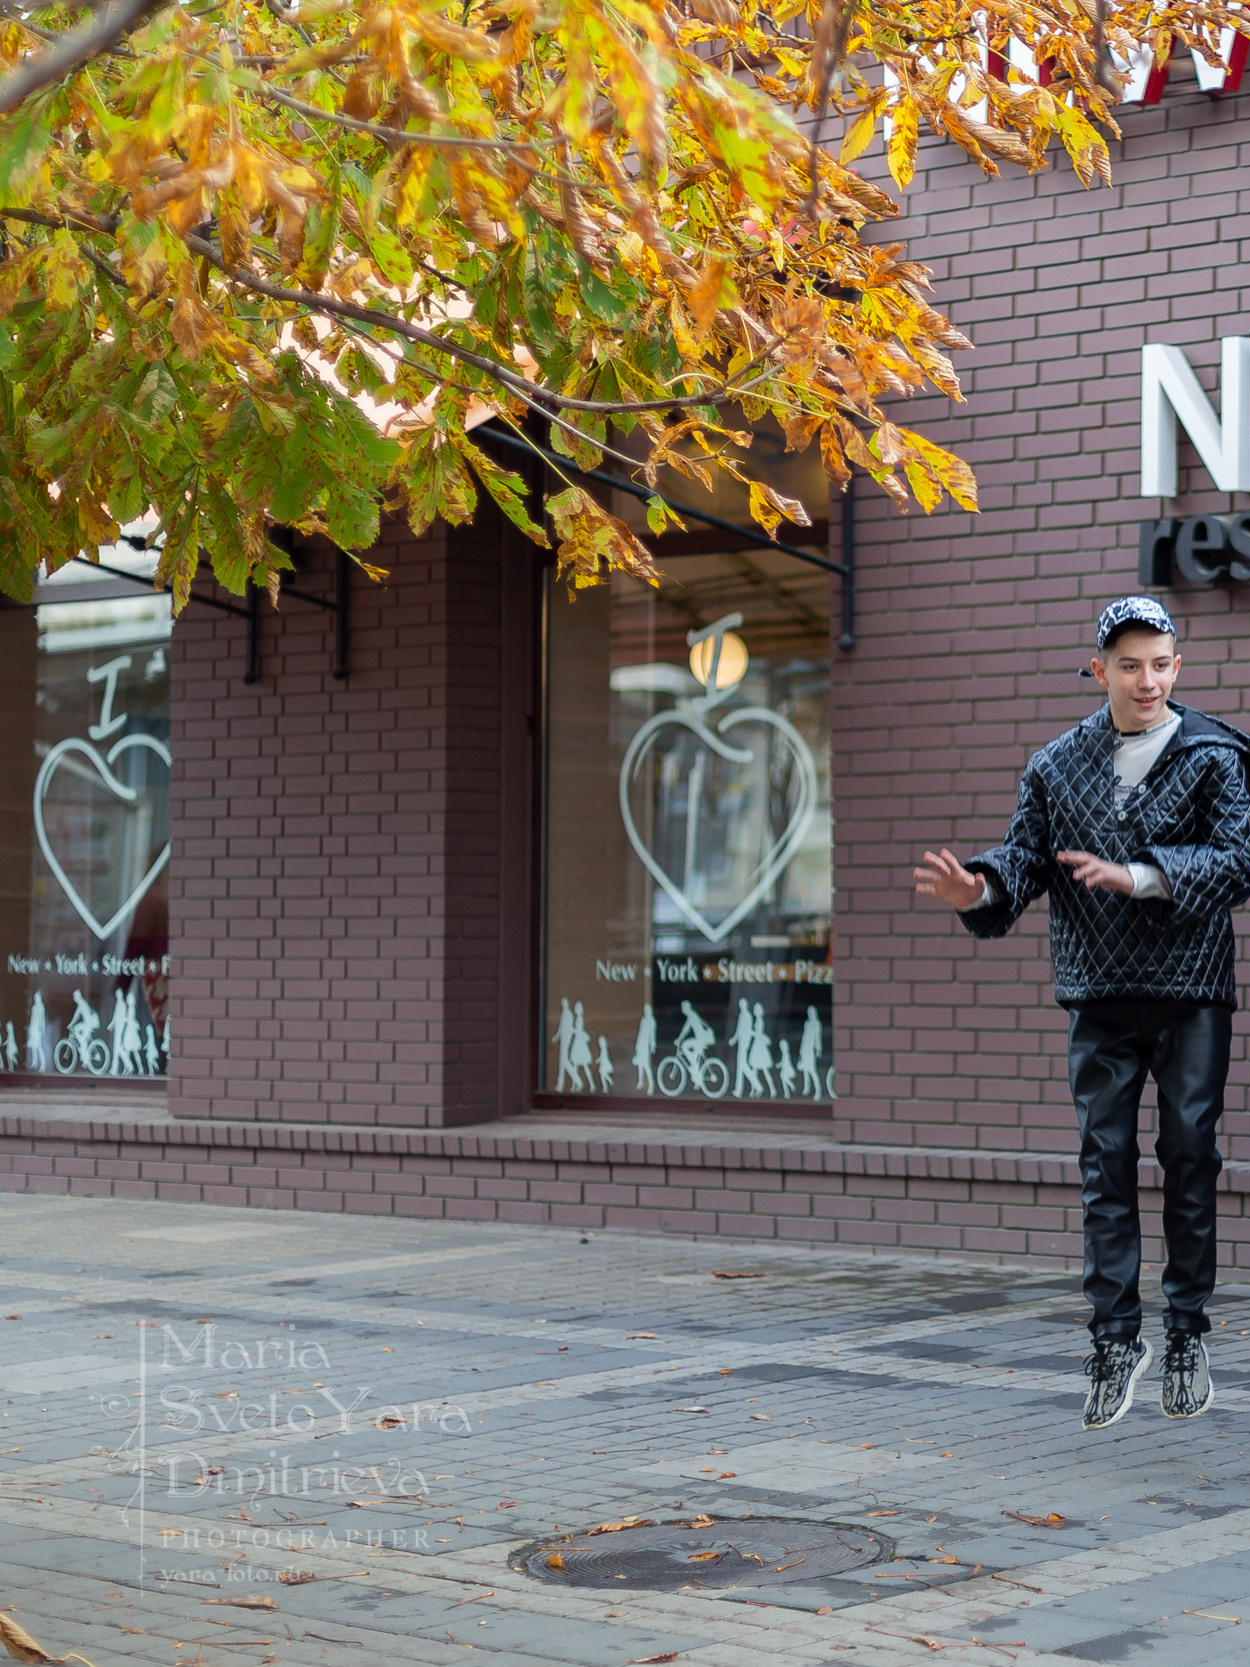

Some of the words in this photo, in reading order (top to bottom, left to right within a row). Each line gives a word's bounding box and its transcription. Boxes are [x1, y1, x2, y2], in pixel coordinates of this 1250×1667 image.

[7, 953, 40, 975] New
[55, 952, 88, 976] York
[101, 952, 145, 976] Street
[596, 958, 637, 982] New
[657, 957, 698, 982] York
[718, 958, 774, 983] Street
